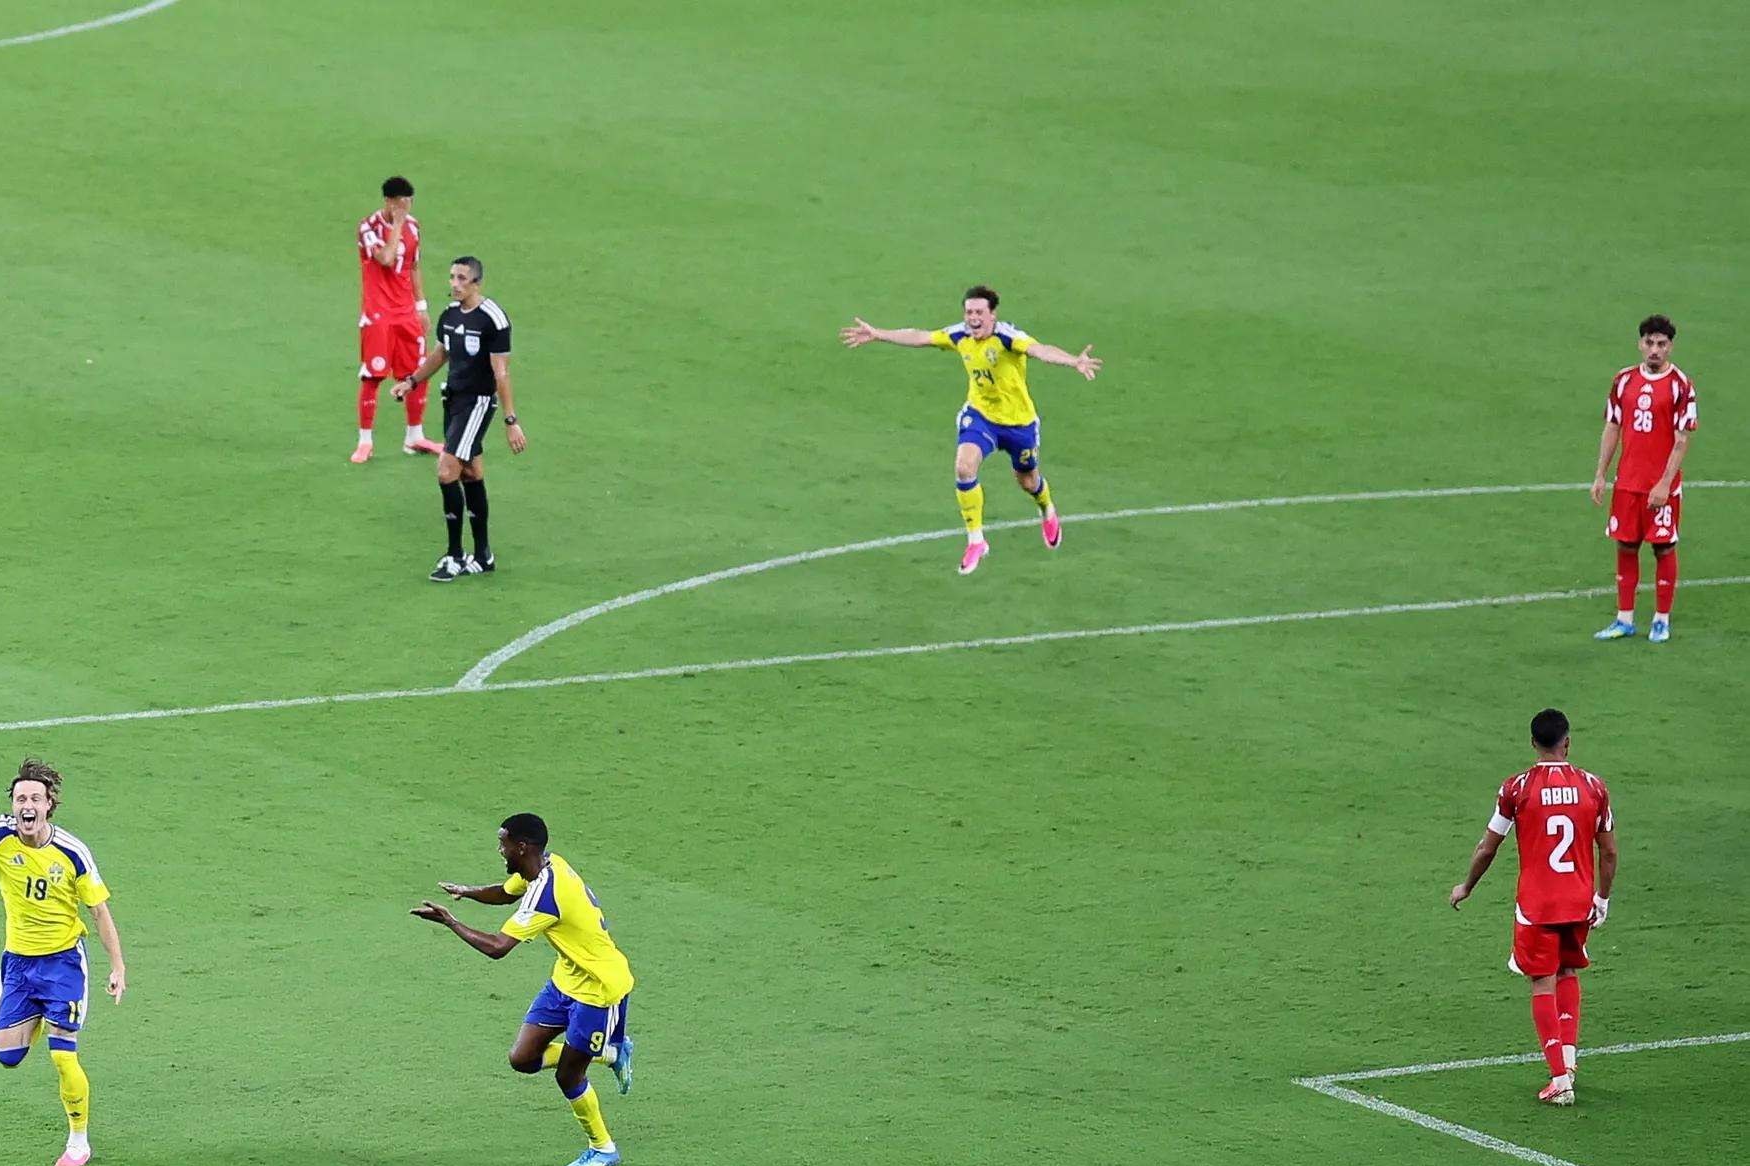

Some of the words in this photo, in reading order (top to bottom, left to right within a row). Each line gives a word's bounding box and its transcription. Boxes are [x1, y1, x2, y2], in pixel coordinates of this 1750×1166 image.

[972, 369, 995, 387] 24
[1632, 408, 1653, 433] 26
[1654, 504, 1673, 528] 26
[1540, 787, 1579, 806] ABDI
[1546, 814, 1576, 873] 2
[25, 876, 48, 901] 19
[590, 1031, 604, 1052] 9
